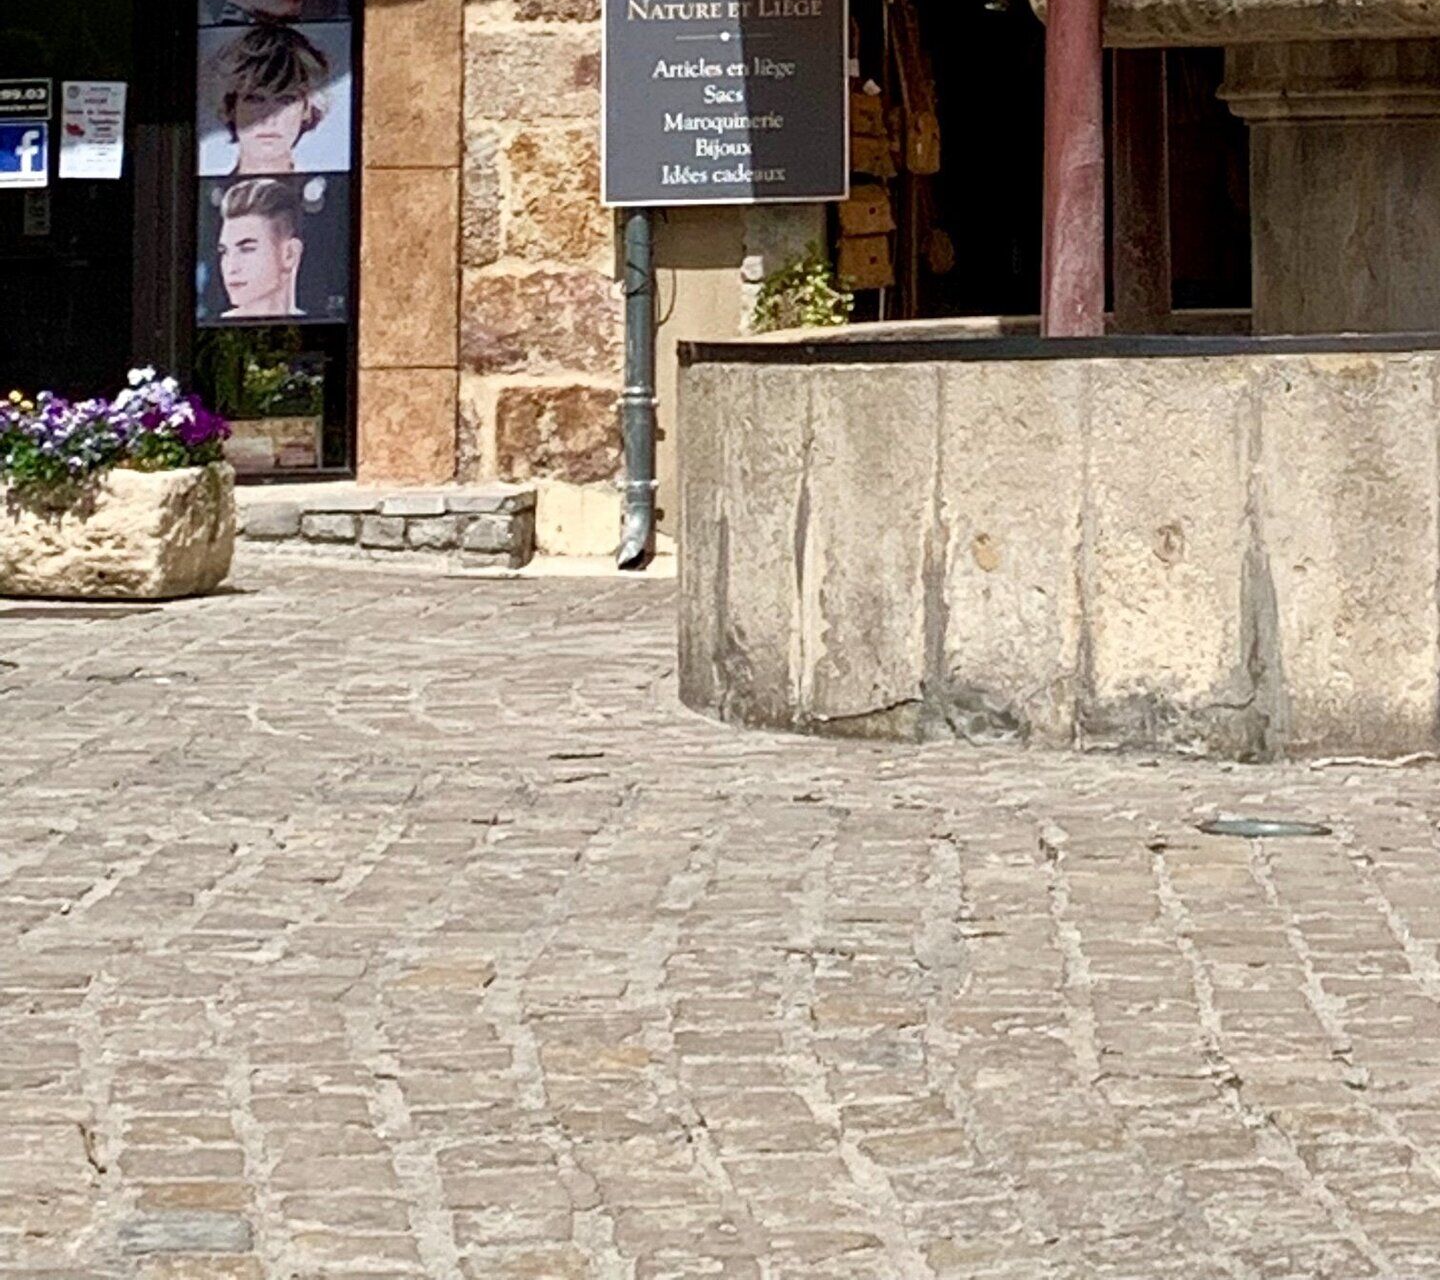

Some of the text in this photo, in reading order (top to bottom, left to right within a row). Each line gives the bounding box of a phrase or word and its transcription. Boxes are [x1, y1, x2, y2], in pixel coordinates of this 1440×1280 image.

[652, 56, 796, 79] Articles en liège
[703, 84, 744, 104] Sacs
[663, 111, 785, 134] Maroquinerie
[695, 138, 752, 160] Bijoux
[661, 162, 787, 185] Idées cadeaux
